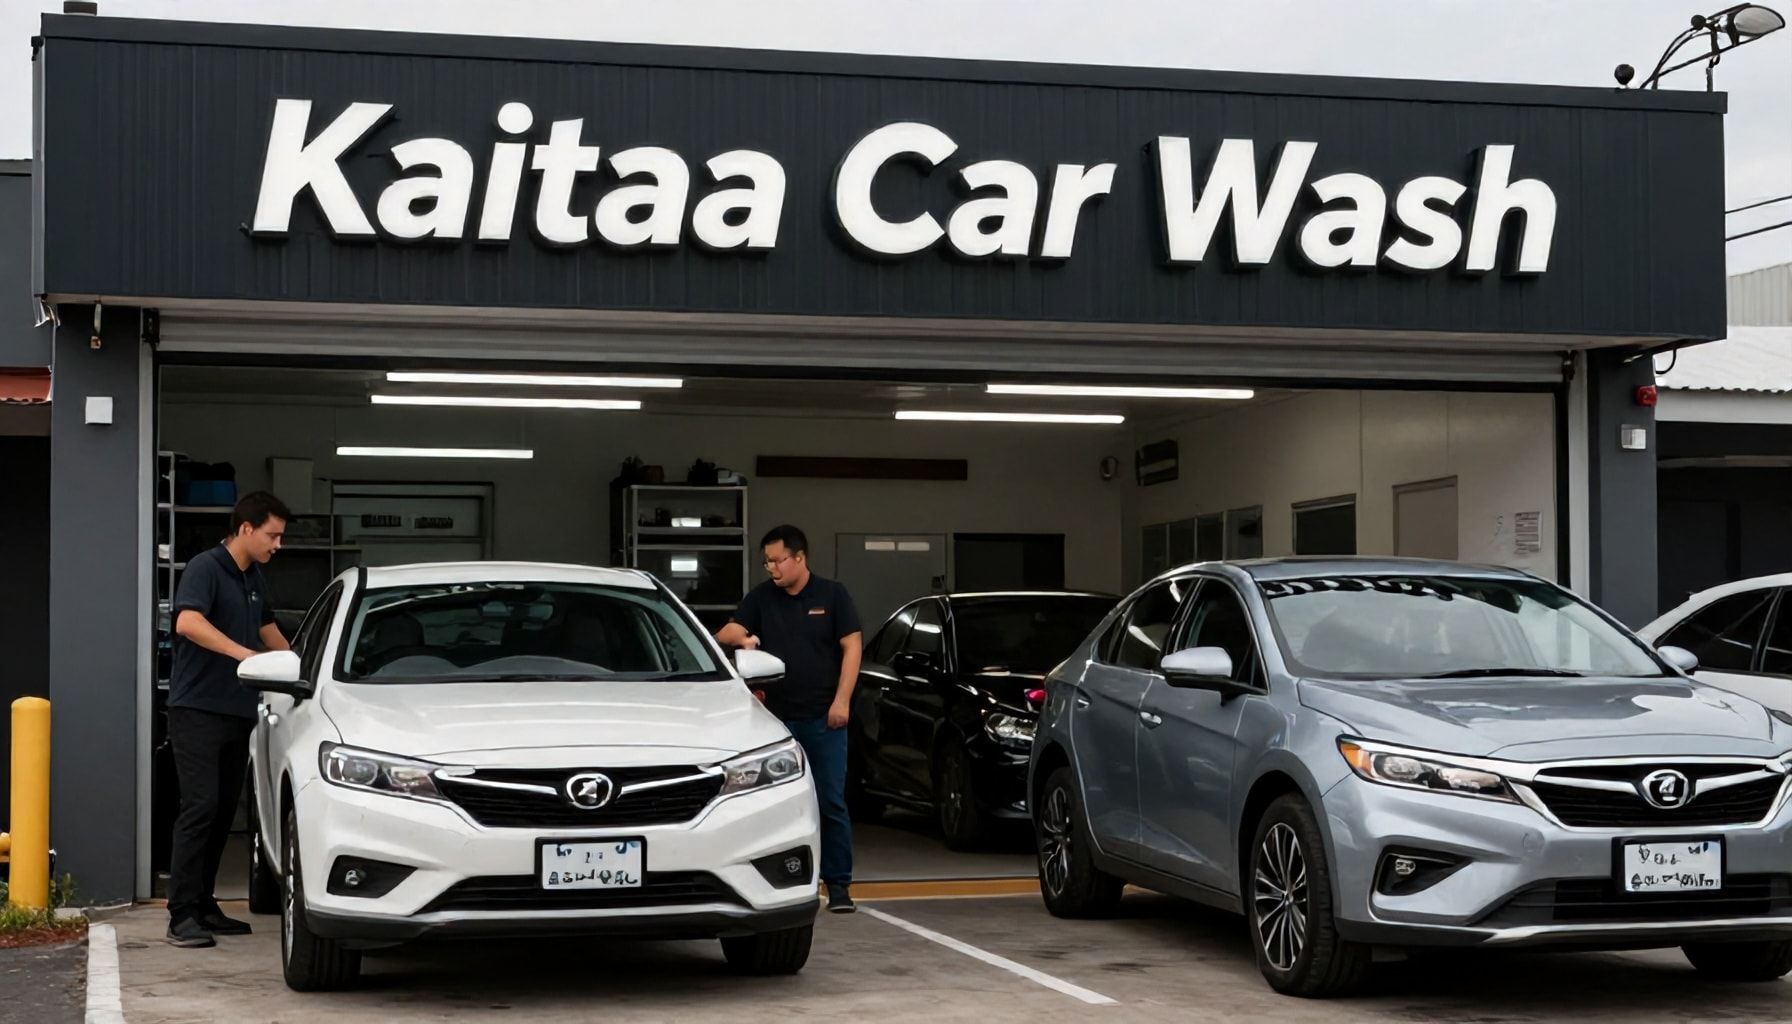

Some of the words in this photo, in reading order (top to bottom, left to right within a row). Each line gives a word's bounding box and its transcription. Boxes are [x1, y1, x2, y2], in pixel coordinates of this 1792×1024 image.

[253, 99, 786, 248] Kaitaa
[836, 123, 1117, 258] Car
[1158, 136, 1557, 273] Wash
